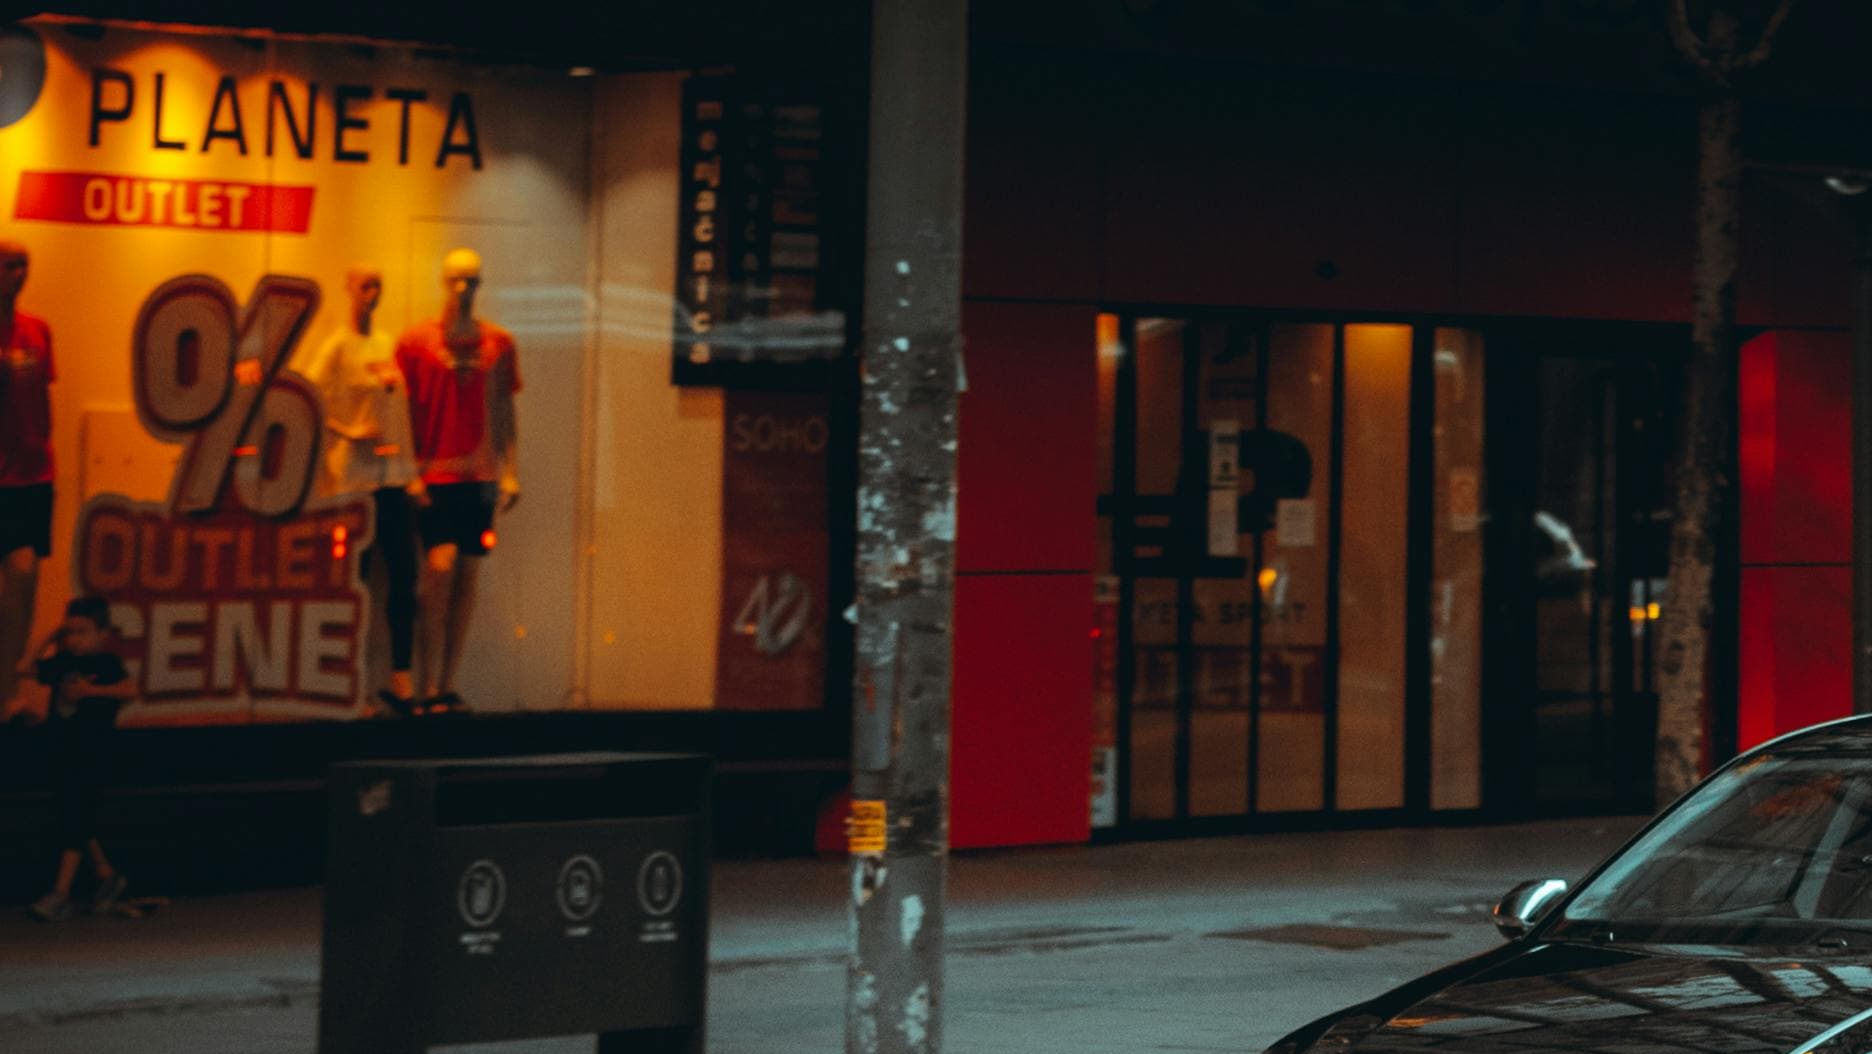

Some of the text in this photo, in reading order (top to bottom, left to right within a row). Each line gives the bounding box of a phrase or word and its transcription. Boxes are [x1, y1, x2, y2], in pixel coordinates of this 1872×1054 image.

[88, 69, 484, 171] PLANETA
[84, 178, 249, 228] OUTLET
[733, 413, 829, 453] SOHO
[88, 511, 362, 590] OUTLET
